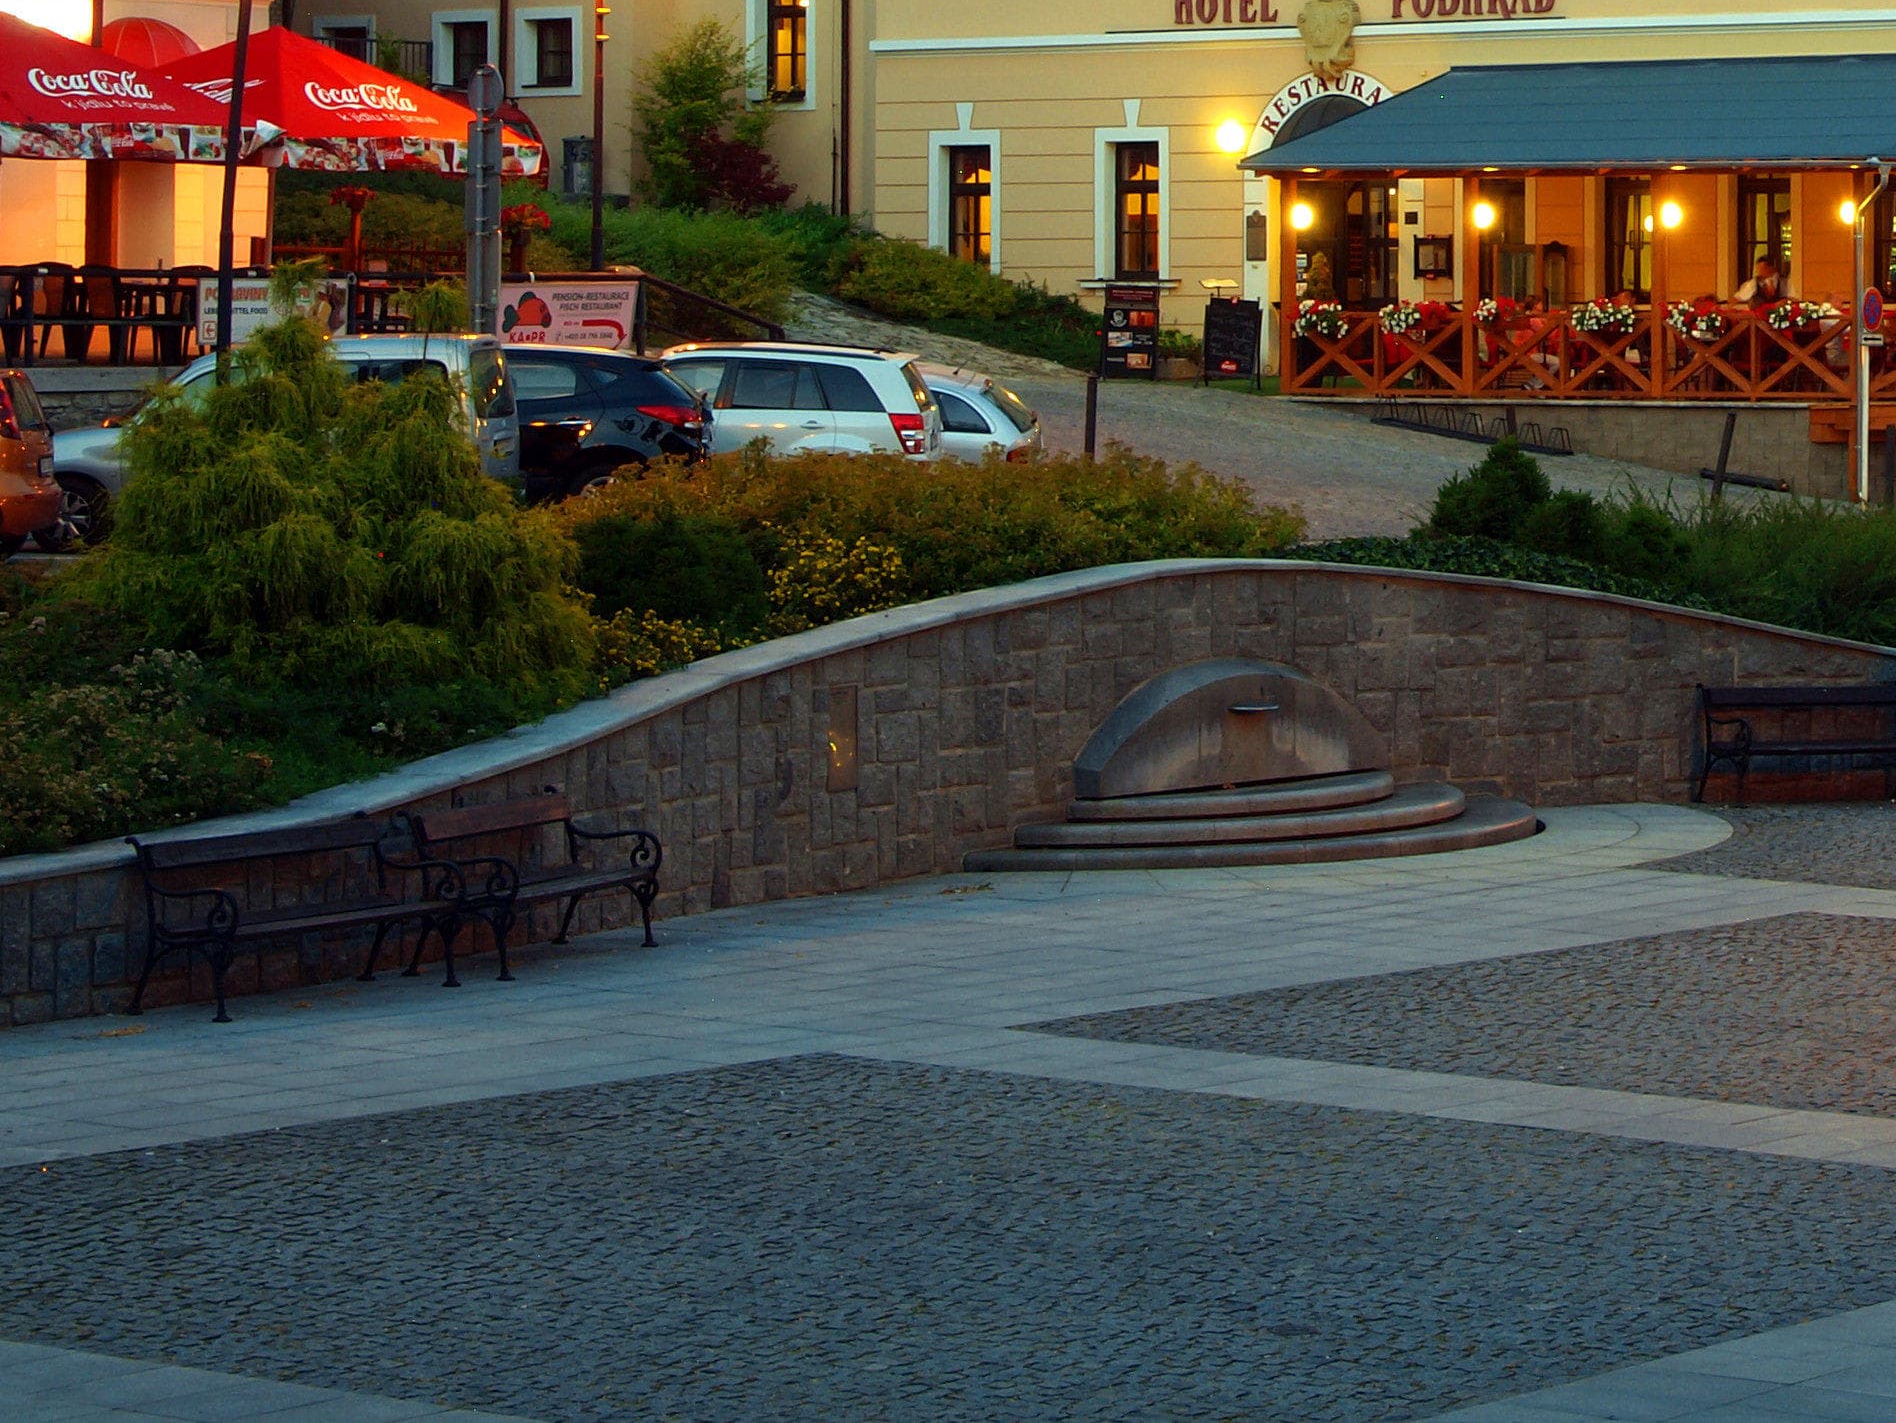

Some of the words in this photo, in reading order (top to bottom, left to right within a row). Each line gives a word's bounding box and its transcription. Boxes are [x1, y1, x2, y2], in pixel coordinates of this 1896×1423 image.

[28, 68, 153, 99] Coca-Cola
[303, 81, 417, 112] Coca-Cola
[1261, 72, 1382, 136] RESTAURA
